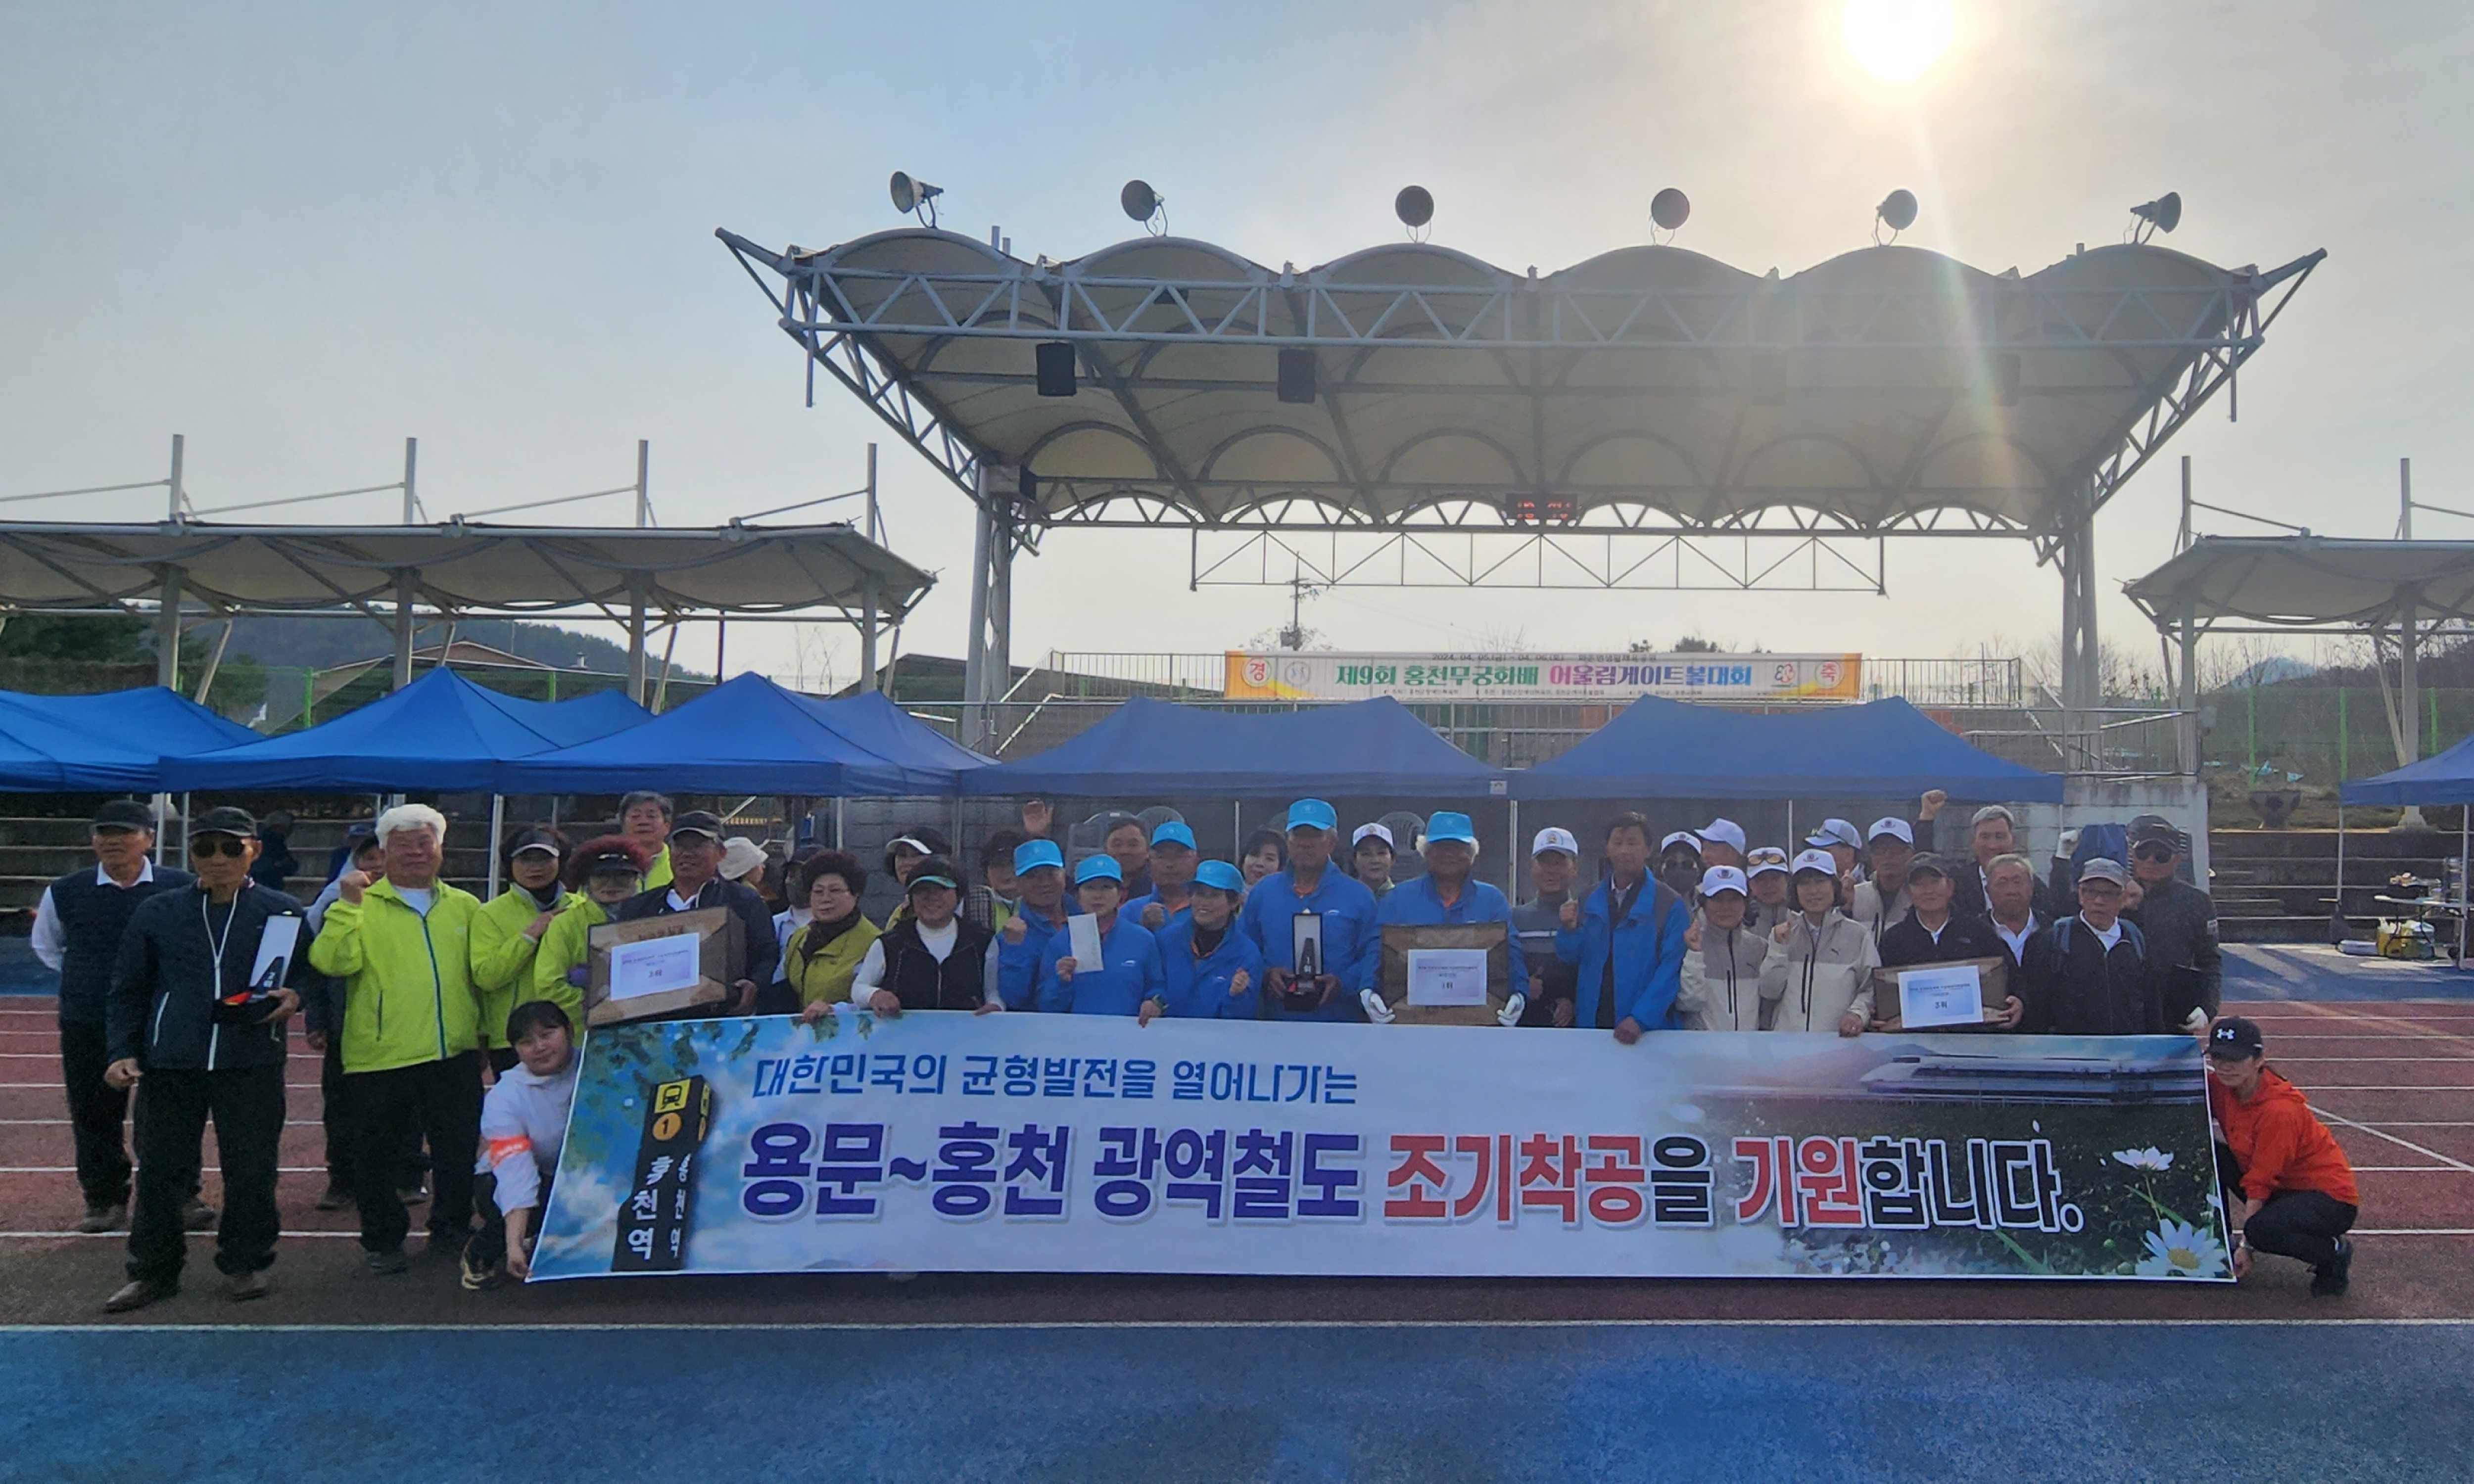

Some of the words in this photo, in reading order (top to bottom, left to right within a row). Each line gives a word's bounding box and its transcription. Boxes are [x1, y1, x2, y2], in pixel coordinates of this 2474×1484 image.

[1250, 662, 1265, 682] 경
[1336, 665, 1395, 686] 제9회
[1404, 665, 1539, 686] 홍천무궁화배
[1549, 665, 1752, 686] 어울림게이트볼대회
[1820, 663, 1839, 683] 축
[752, 1053, 947, 1099] 대한민국의
[962, 1054, 1156, 1099] 균형발전을
[1173, 1060, 1357, 1104] 열어나가는
[742, 1121, 1069, 1216] 용문~홍천
[1094, 1126, 1360, 1219] 광역철도
[1384, 1132, 1713, 1223] 조기착공을
[1735, 1136, 2084, 1232] 기원합니다.
